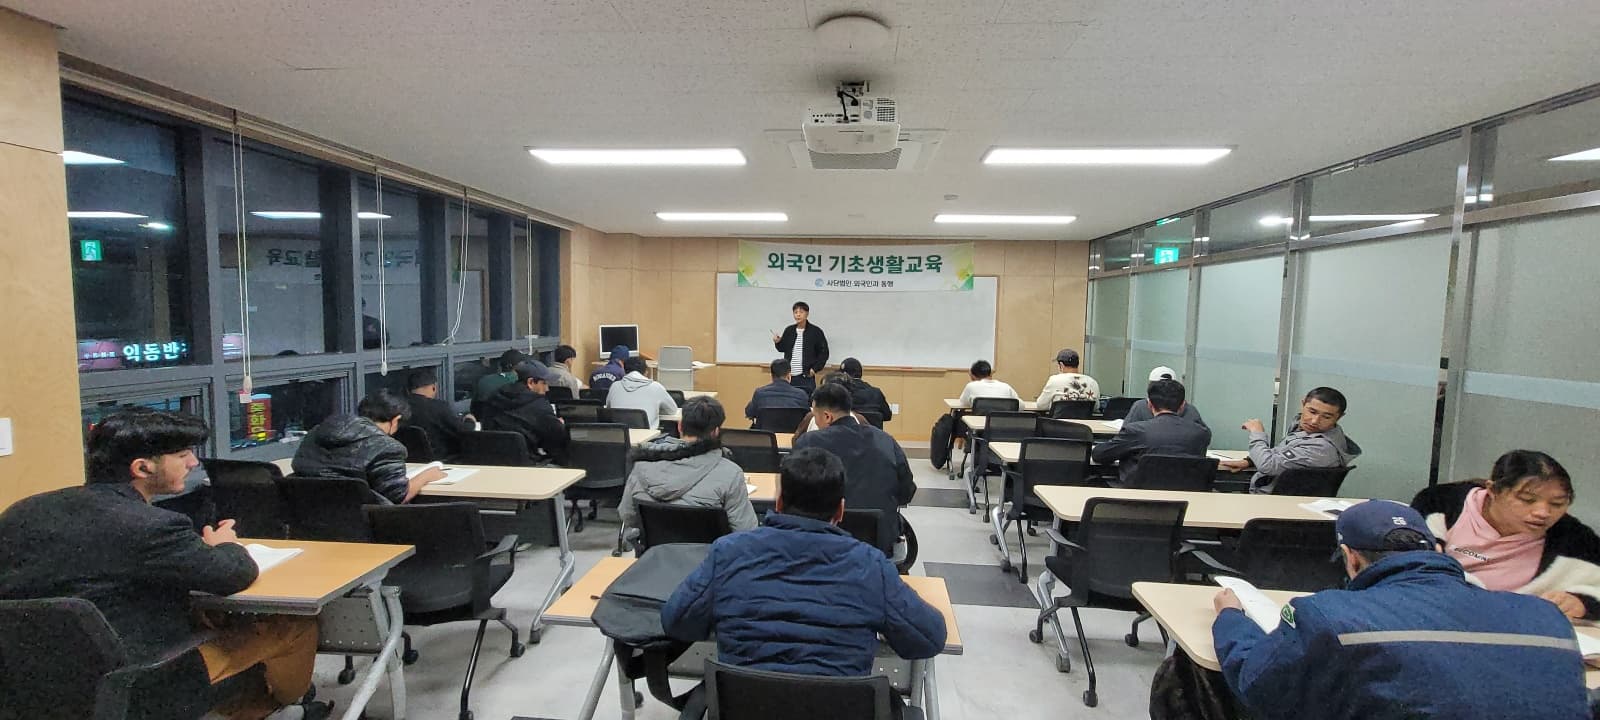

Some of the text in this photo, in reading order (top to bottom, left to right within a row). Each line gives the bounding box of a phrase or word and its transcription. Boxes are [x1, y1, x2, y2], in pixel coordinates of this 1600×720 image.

[767, 252, 943, 275] 외국인 기초생활교육
[826, 279, 894, 288] 사단법인 외국인과 동행
[122, 341, 187, 362] 익동반
